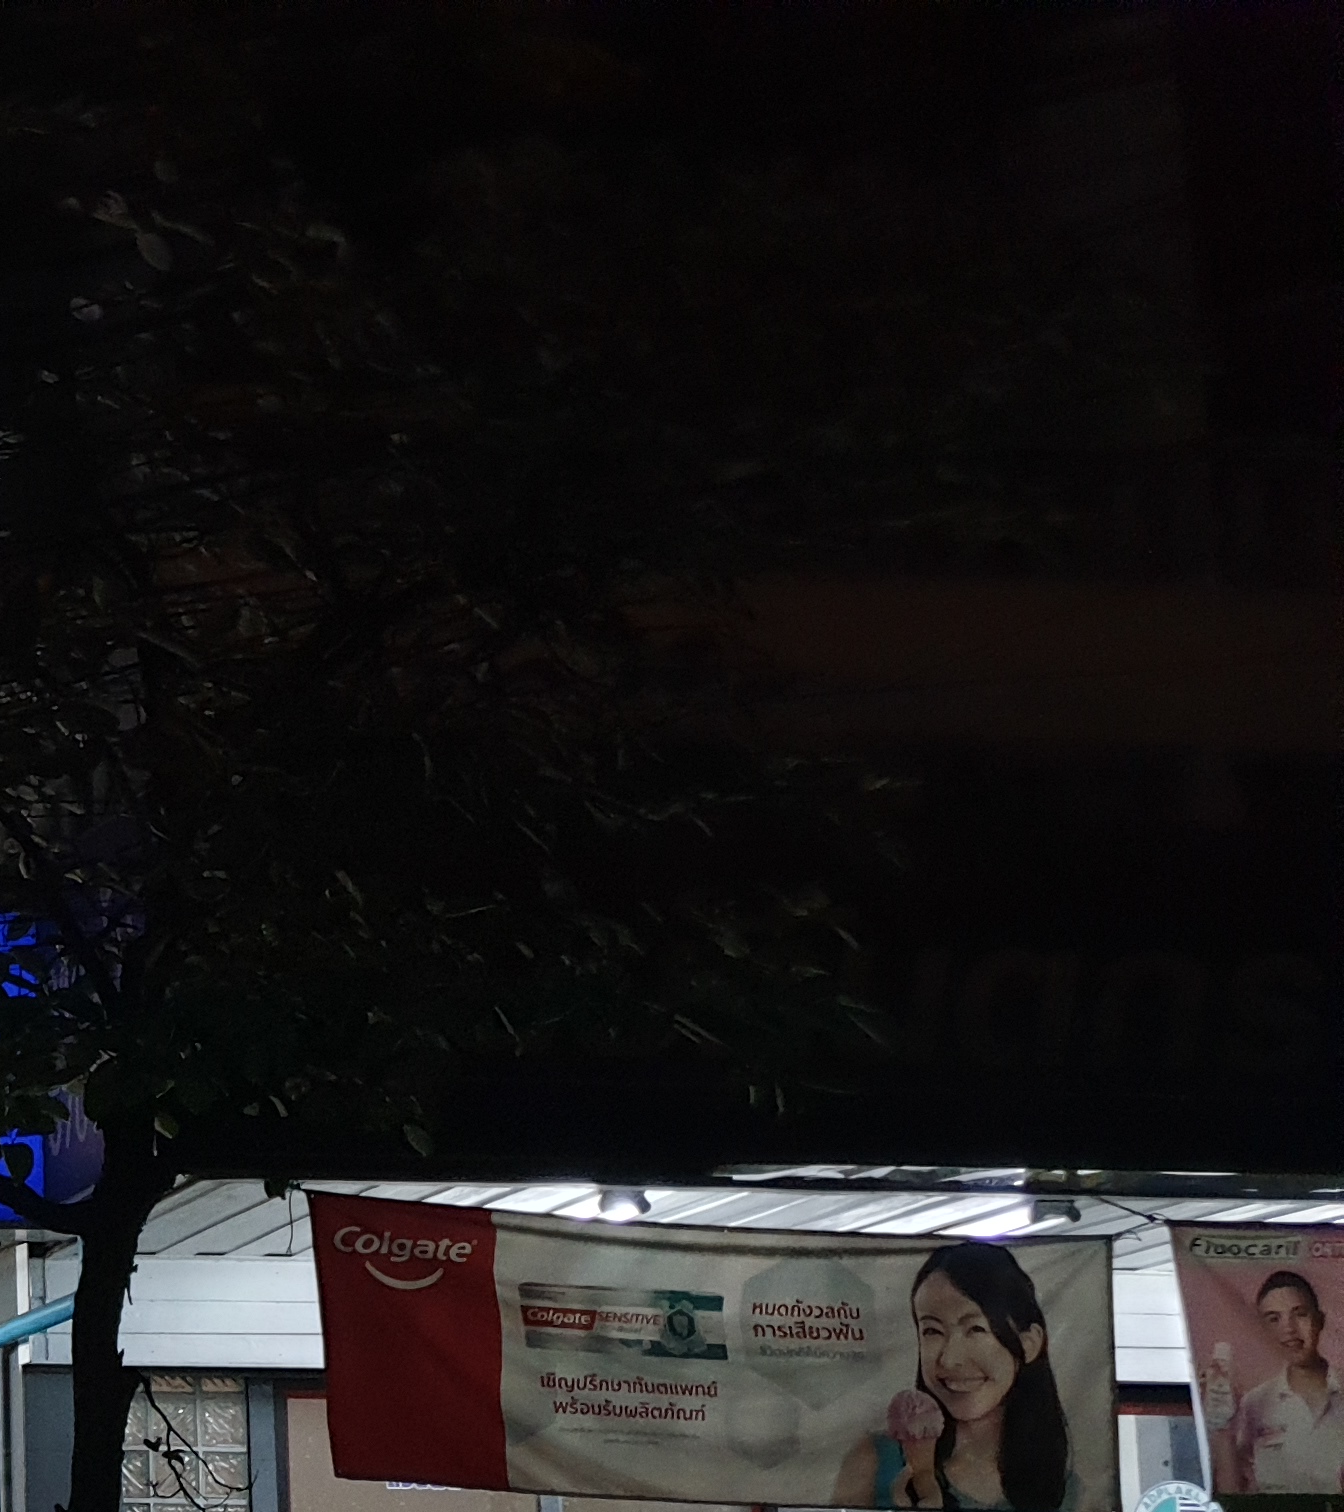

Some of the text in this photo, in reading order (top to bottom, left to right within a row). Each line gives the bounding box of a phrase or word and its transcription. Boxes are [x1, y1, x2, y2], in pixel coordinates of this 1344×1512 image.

[333, 1225, 477, 1263] Colgate
[526, 1308, 662, 1326] Colgate SENSITIVE
[752, 1299, 861, 1320] หมดกังวลกับ
[753, 1320, 865, 1341] การเสียวฟัน
[540, 1373, 718, 1398] เชิญปรึกษาทันตแพทย์
[553, 1397, 706, 1421] พร้อมรับผลิตภัณฑ์
